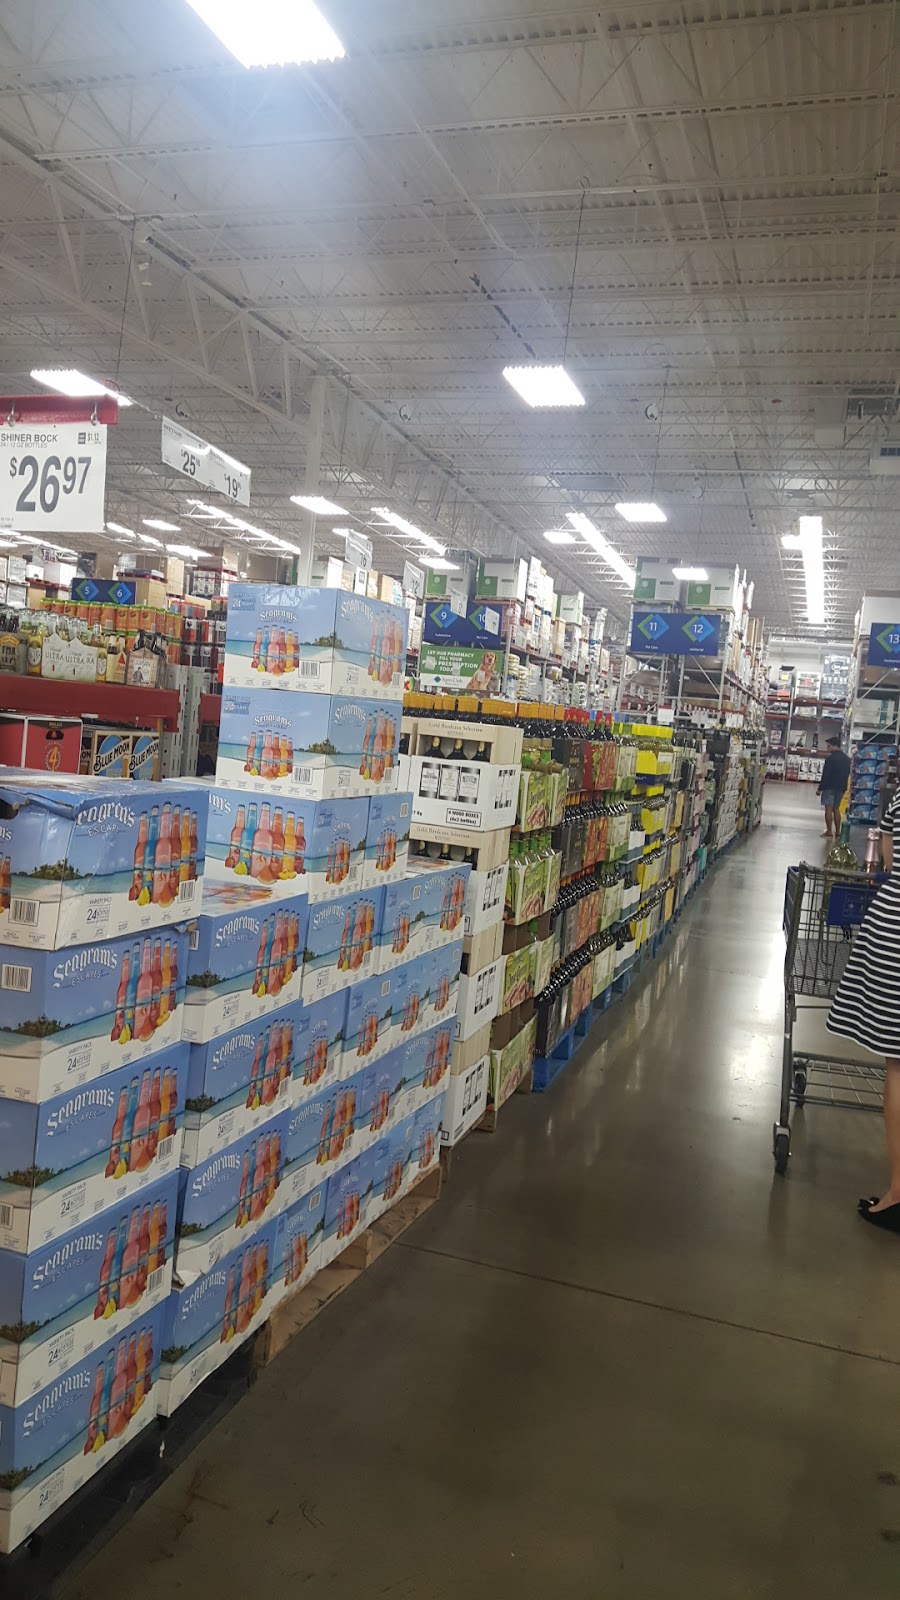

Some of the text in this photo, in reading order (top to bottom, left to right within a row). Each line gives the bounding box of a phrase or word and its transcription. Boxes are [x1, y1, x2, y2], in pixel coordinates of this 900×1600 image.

[1, 433, 58, 443] SHINER BOCK
[87, 432, 100, 442] $1.12
[84, 587, 123, 598] 5 6
[441, 611, 447, 620] 9
[649, 622, 704, 633] 11 12
[889, 633, 900, 644] 13
[45, 651, 64, 661] ULTRA
[65, 655, 85, 665] ULTRA
[49, 745, 59, 772] 4
[93, 740, 131, 772] BLUE MOON
[129, 751, 146, 771] BLUE
[86, 908, 98, 921] 24
[215, 915, 260, 948] Seagram's
[52, 947, 118, 989] Seagram's
[212, 1033, 256, 1071] Seagram's
[67, 1056, 77, 1071] 24
[47, 1087, 116, 1137] Seagram's
[191, 1153, 241, 1198] Seagram's
[60, 1199, 71, 1215] 24
[32, 1231, 105, 1292] Seagram's
[48, 1347, 59, 1364] 24
[22, 1370, 92, 1438] Seagram's
[39, 1490, 49, 1507] 24
